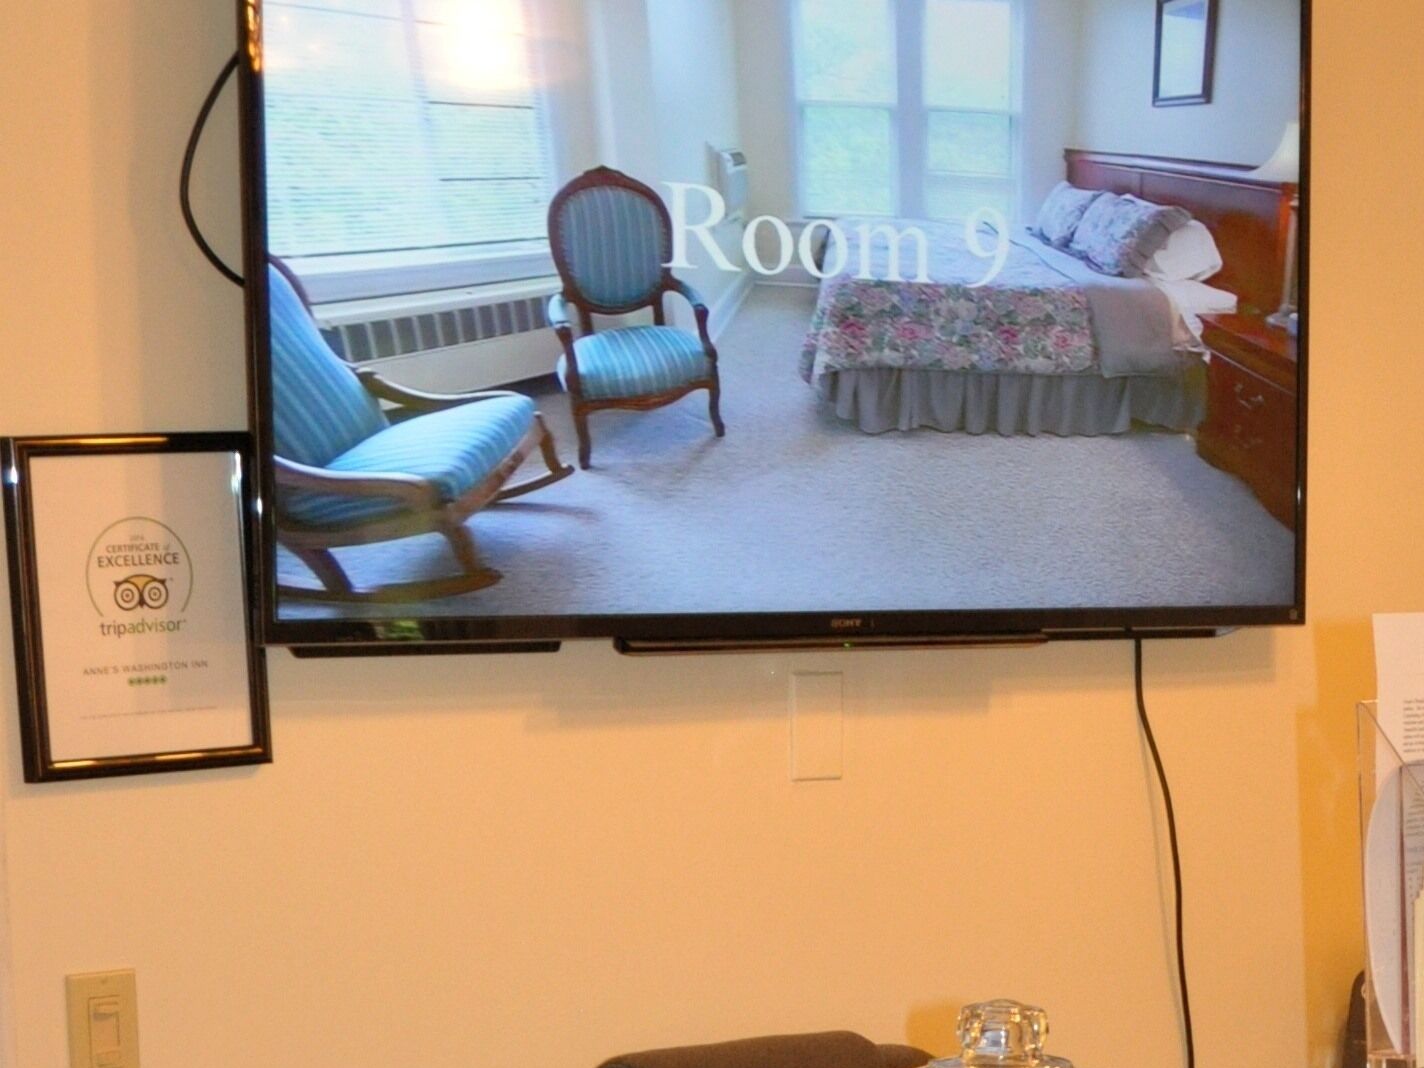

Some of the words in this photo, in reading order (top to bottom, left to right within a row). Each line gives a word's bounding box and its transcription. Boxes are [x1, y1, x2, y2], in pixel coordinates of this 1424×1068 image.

[661, 181, 935, 284] Room
[964, 207, 1010, 288] 9
[105, 543, 160, 554] CERTIFICATE
[97, 552, 180, 568] EXCELLENCE
[100, 618, 182, 639] tripadvisor
